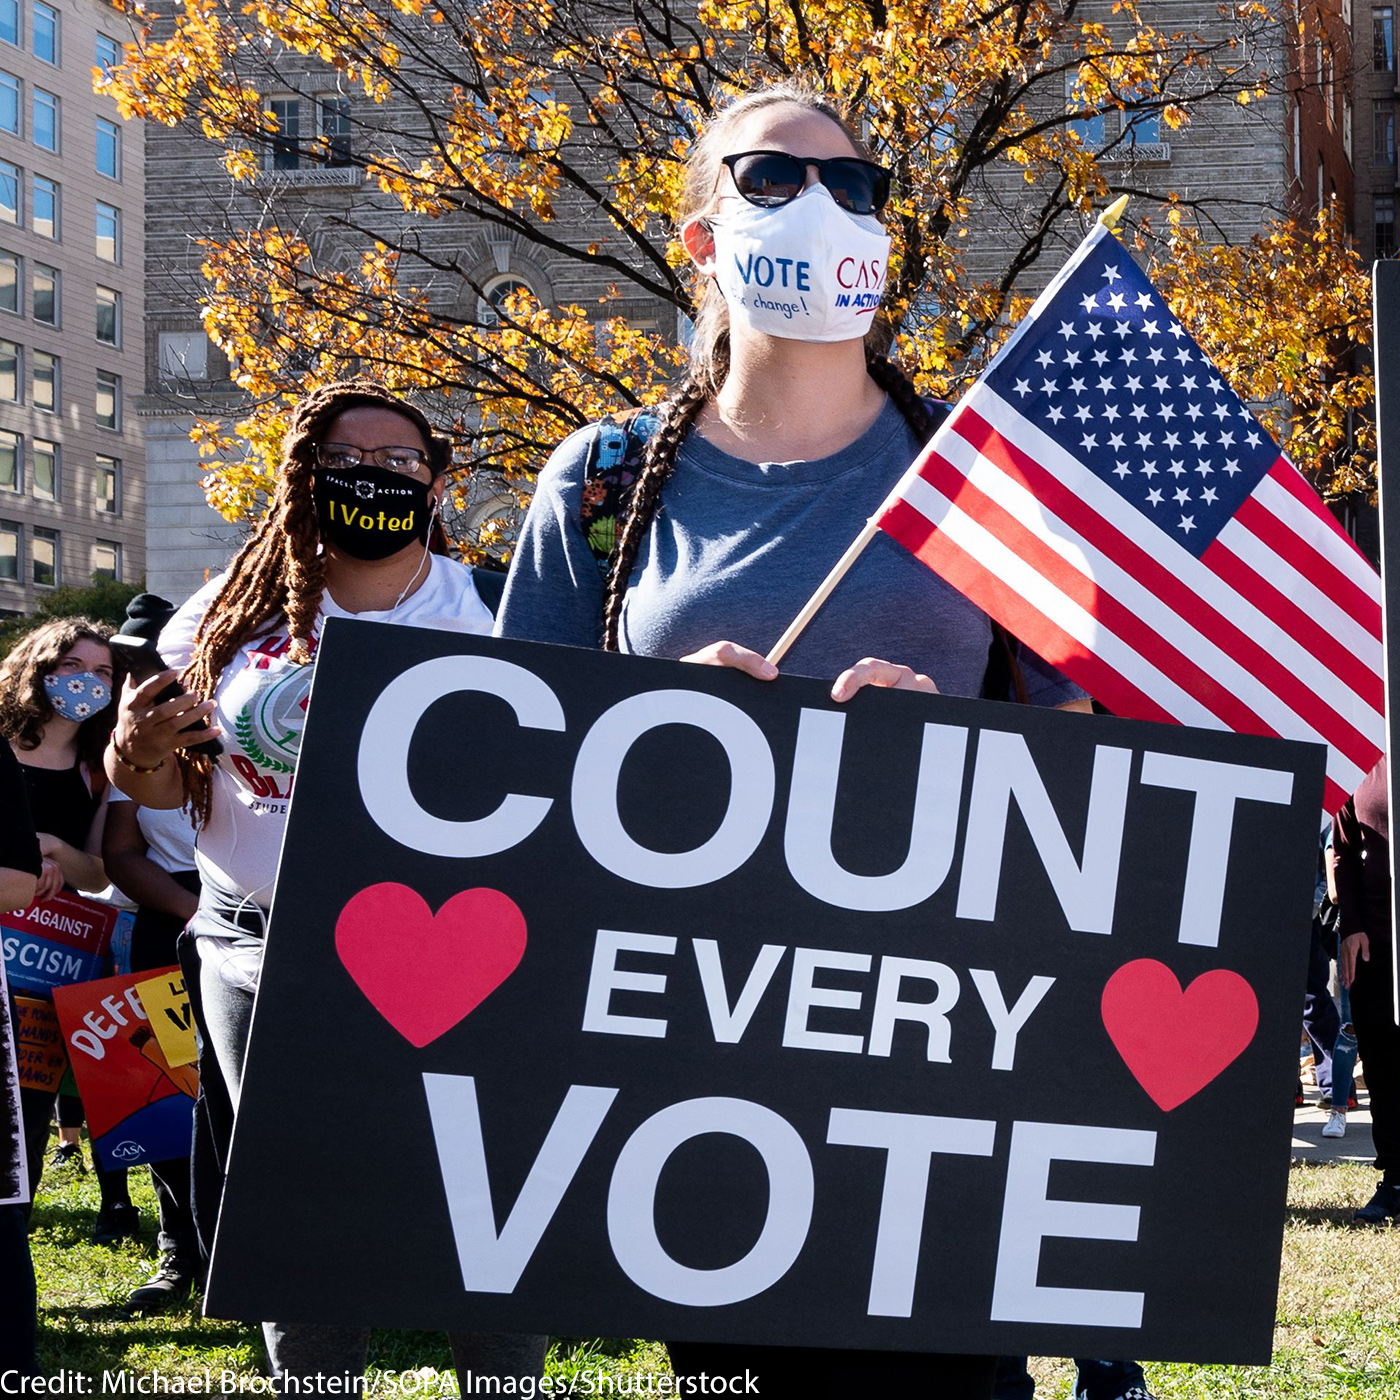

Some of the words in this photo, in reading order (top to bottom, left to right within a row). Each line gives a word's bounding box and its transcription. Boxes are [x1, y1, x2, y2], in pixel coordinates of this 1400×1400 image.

[734, 253, 810, 291] VOTE
[754, 293, 810, 319] change!
[835, 293, 850, 307] IN
[377, 488, 413, 496] ACTION
[329, 500, 335, 520] I
[341, 504, 414, 532] Voted
[358, 656, 1294, 947] COUNT
[27, 906, 93, 938] AGAINST
[582, 930, 1056, 1070] EVERY
[112, 1143, 146, 1159] CASA
[423, 1073, 1157, 1328] VOTE
